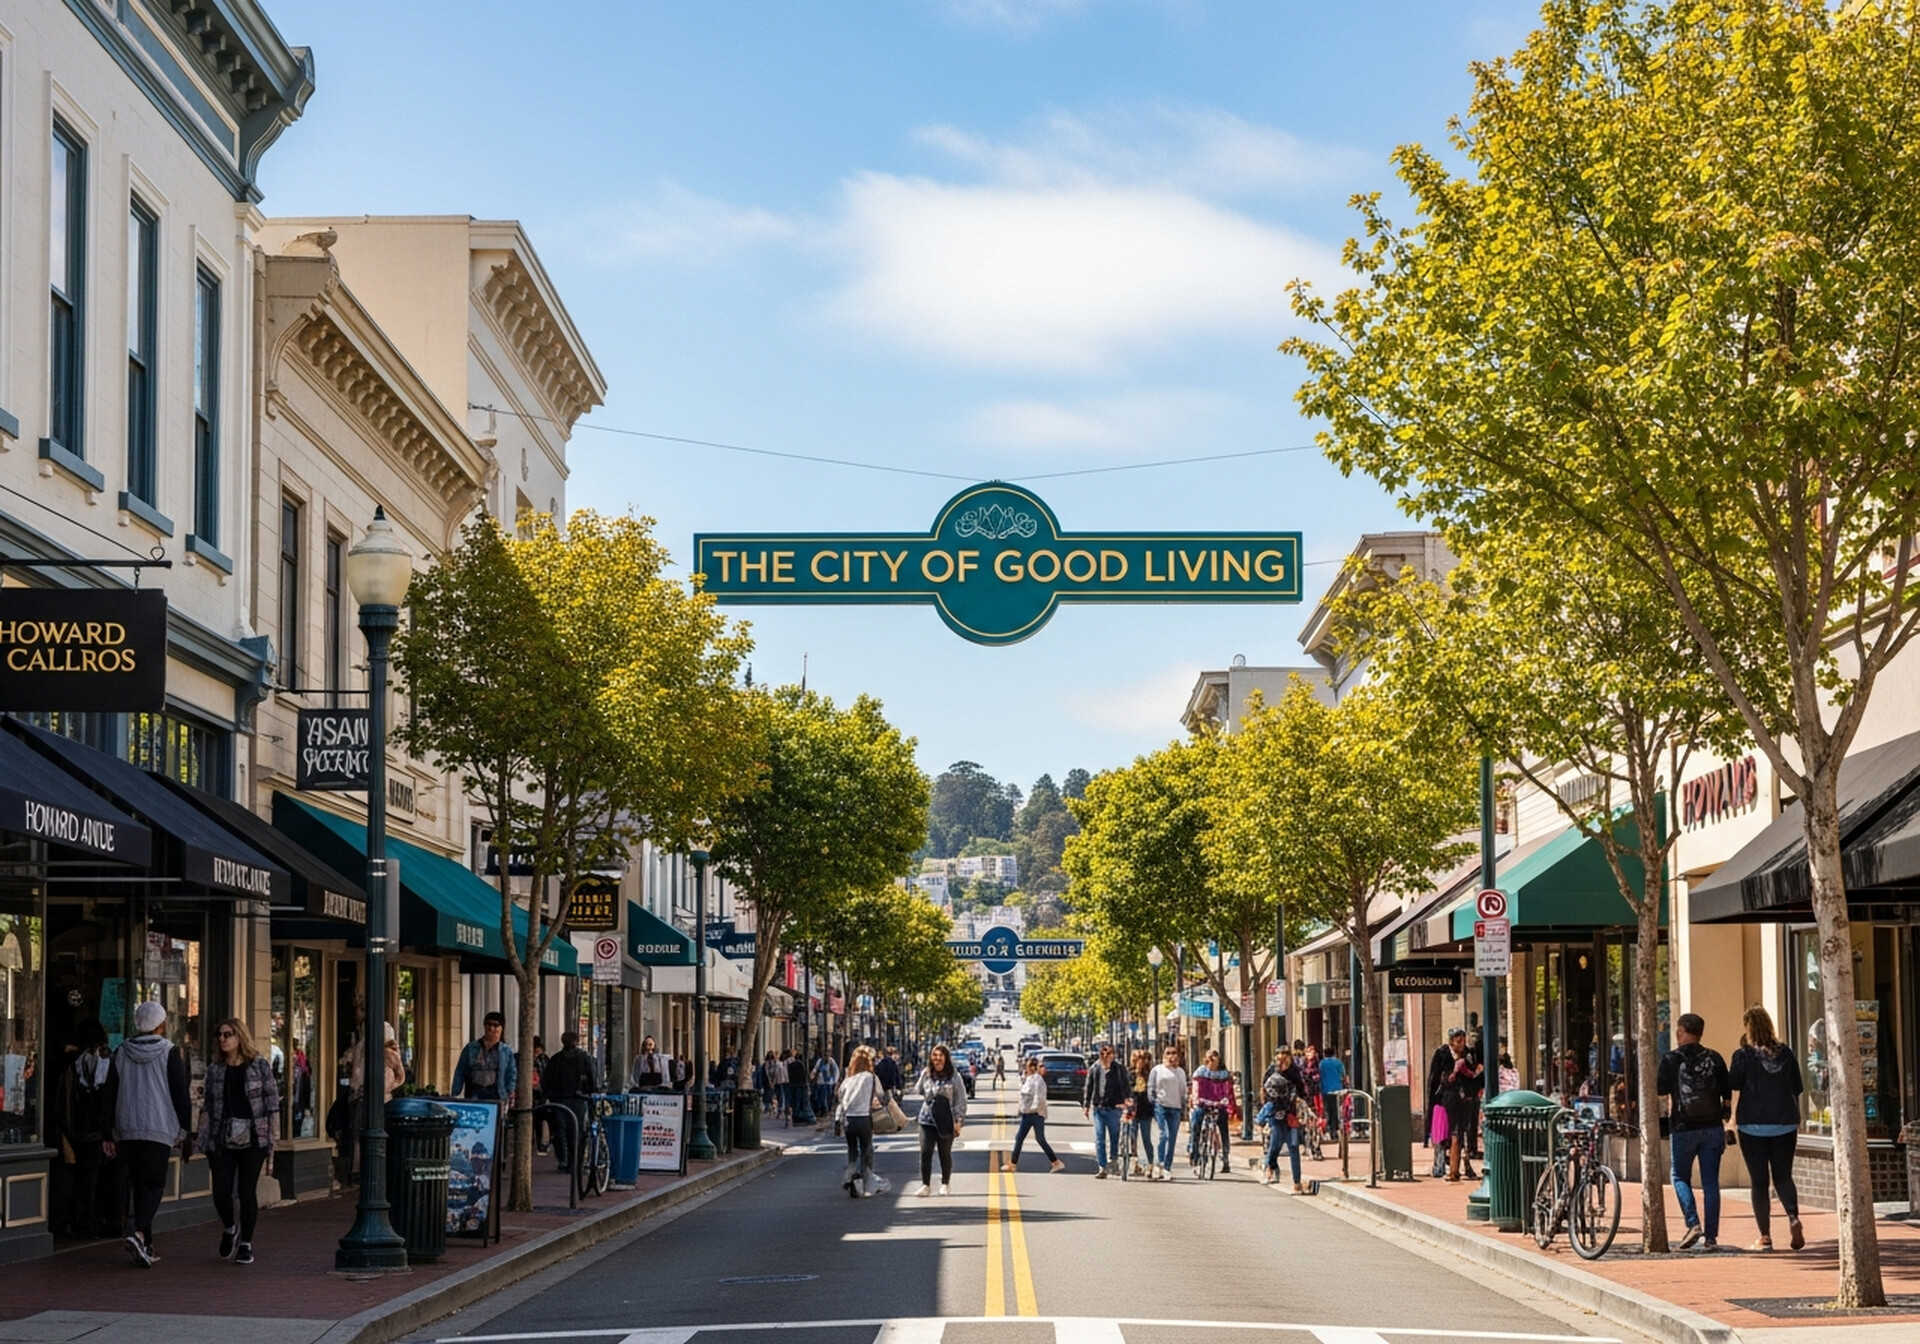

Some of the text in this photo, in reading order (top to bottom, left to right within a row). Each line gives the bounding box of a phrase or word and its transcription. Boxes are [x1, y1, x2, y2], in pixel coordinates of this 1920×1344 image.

[712, 549, 1285, 583] THE CITY OF GOOD LIVING
[0, 621, 126, 645] HOWARD
[7, 648, 136, 672] CALLROS
